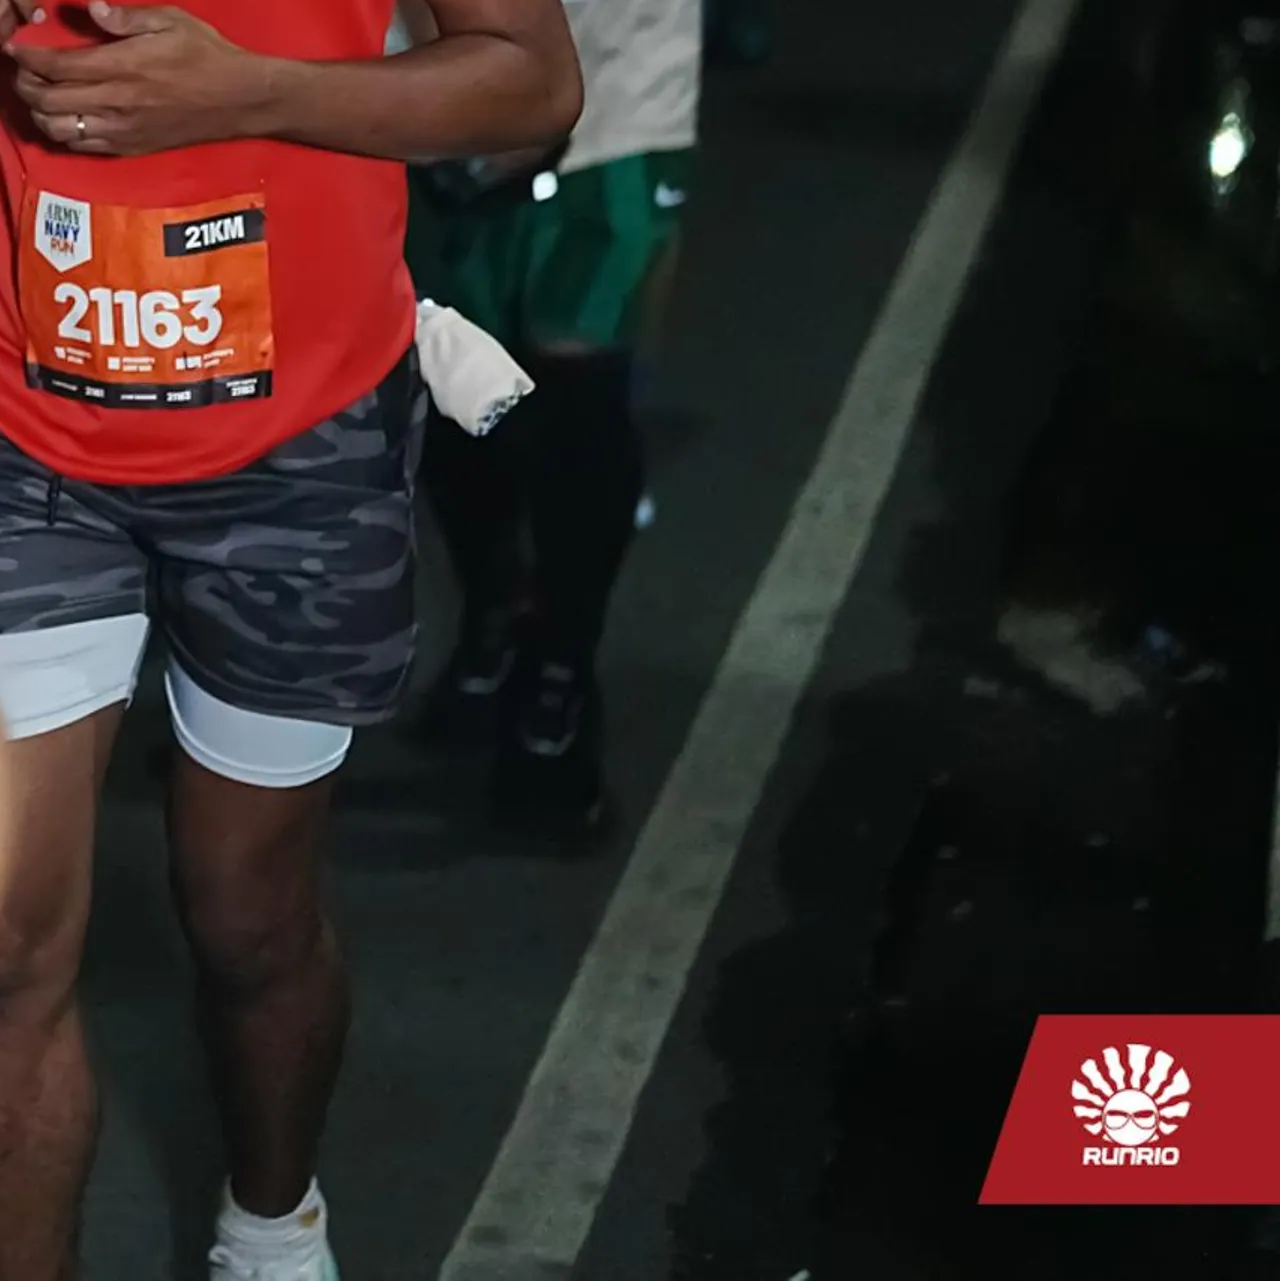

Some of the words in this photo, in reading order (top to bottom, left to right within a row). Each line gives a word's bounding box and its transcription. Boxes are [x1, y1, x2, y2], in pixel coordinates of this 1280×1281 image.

[44, 203, 81, 226] ARMY
[45, 220, 81, 242] NAVY
[185, 215, 244, 250] 21KM
[50, 237, 75, 255] RUN
[53, 281, 223, 350] 21163
